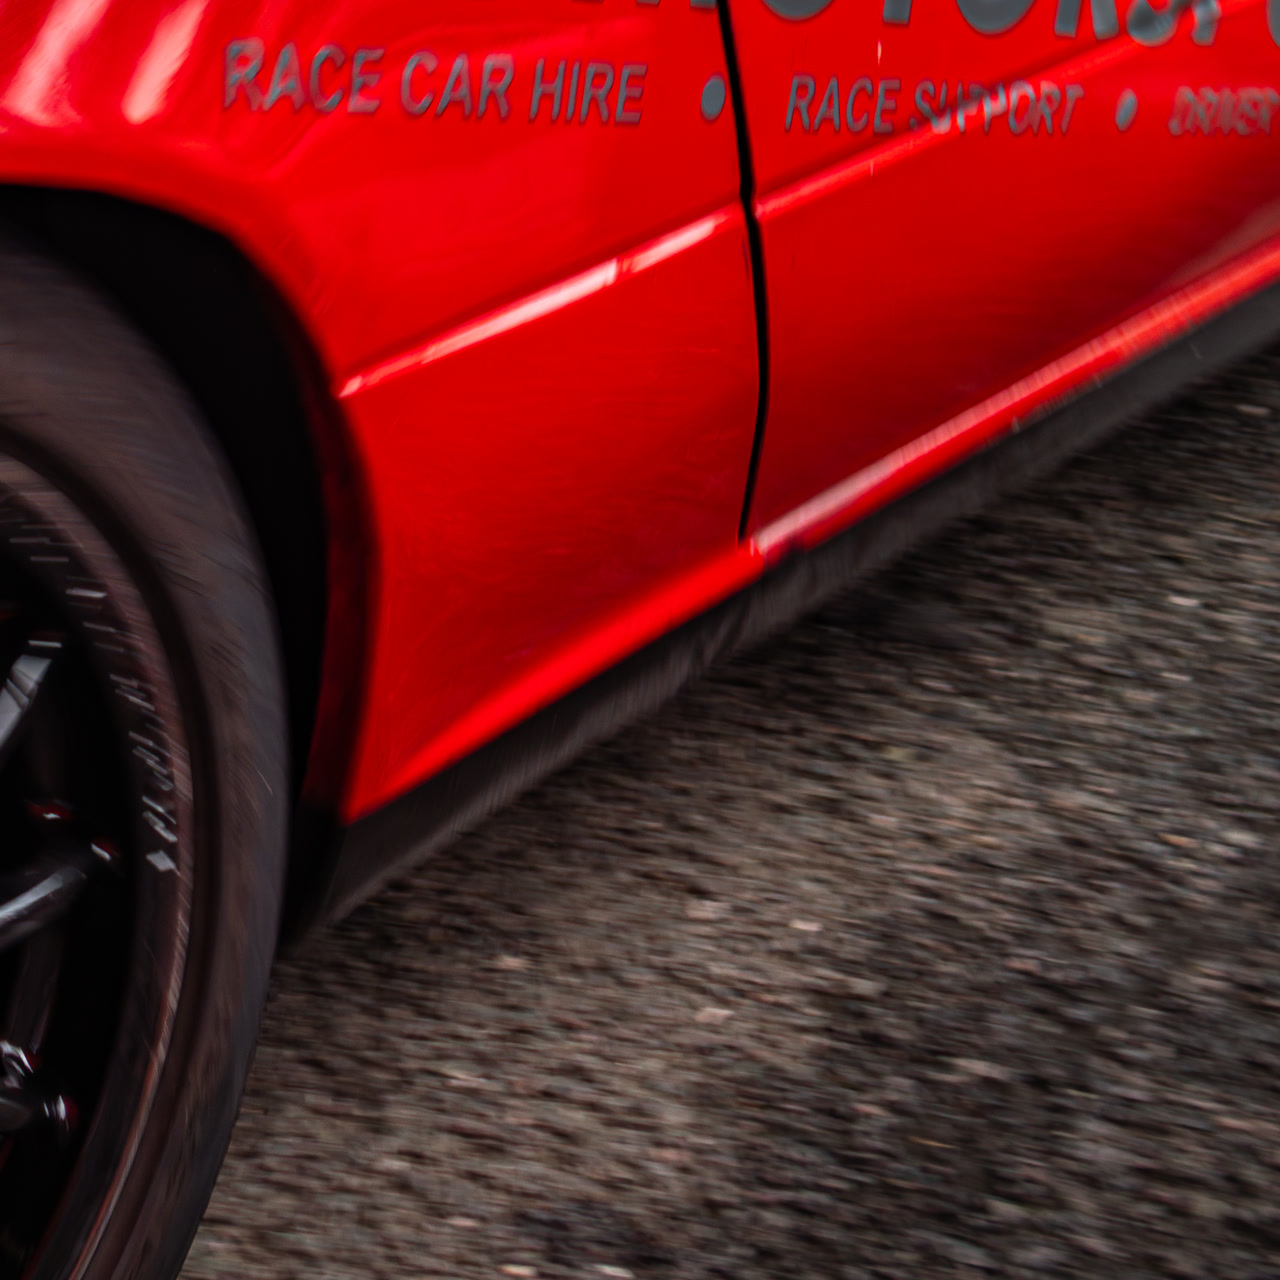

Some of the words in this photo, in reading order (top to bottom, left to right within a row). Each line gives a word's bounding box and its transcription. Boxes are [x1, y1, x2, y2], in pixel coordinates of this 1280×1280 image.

[222, 37, 386, 115] RACE
[400, 50, 515, 120] CAR
[528, 56, 649, 126] HIRE
[784, 72, 902, 134] RACE
[908, 78, 1086, 136] SUPPORT
